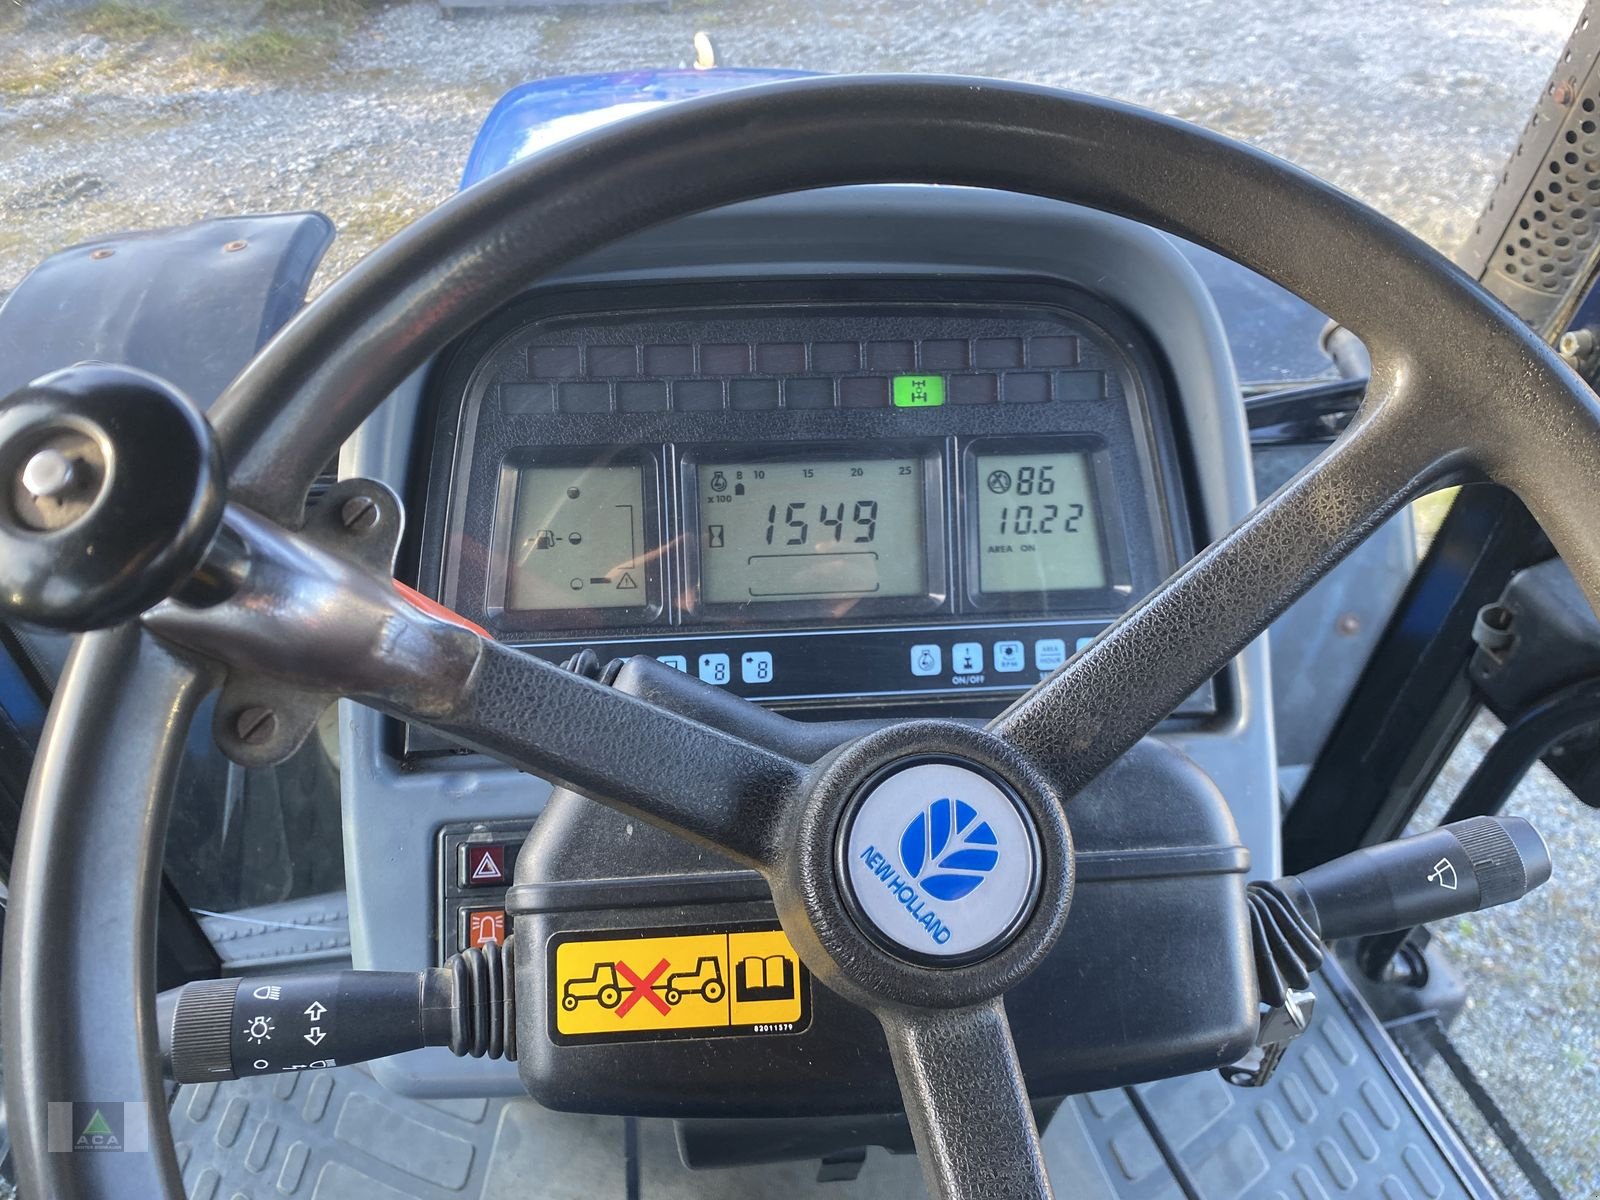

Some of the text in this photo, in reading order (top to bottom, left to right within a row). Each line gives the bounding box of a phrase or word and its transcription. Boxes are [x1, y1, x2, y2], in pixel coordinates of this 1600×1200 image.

[753, 470, 766, 480] 10
[802, 468, 814, 478] 15
[850, 467, 864, 477] 20
[898, 466, 912, 475] 25
[1016, 466, 1055, 496] 86
[766, 501, 878, 545] 1549
[1000, 503, 1084, 535] 10.22
[987, 544, 1036, 553] AREA ON
[952, 674, 985, 685] ON/OFF
[860, 845, 951, 945] NEW HOLLAND
